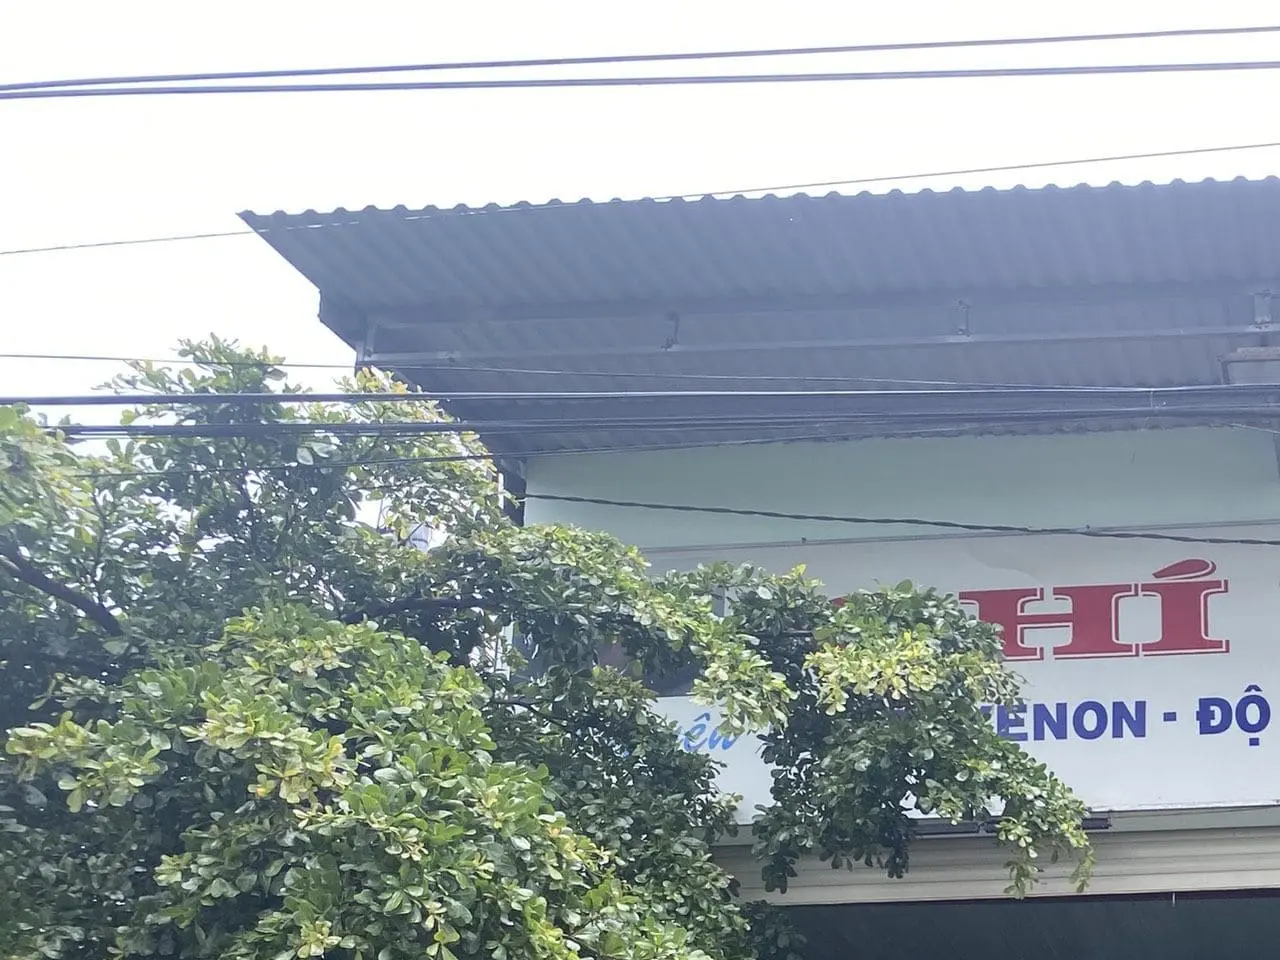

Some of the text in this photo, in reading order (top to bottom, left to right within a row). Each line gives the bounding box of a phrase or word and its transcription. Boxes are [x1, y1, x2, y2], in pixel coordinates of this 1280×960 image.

[959, 559, 1230, 661] HÍ
[978, 700, 1147, 741] ENON
[1196, 684, 1272, 746] ĐỘ
